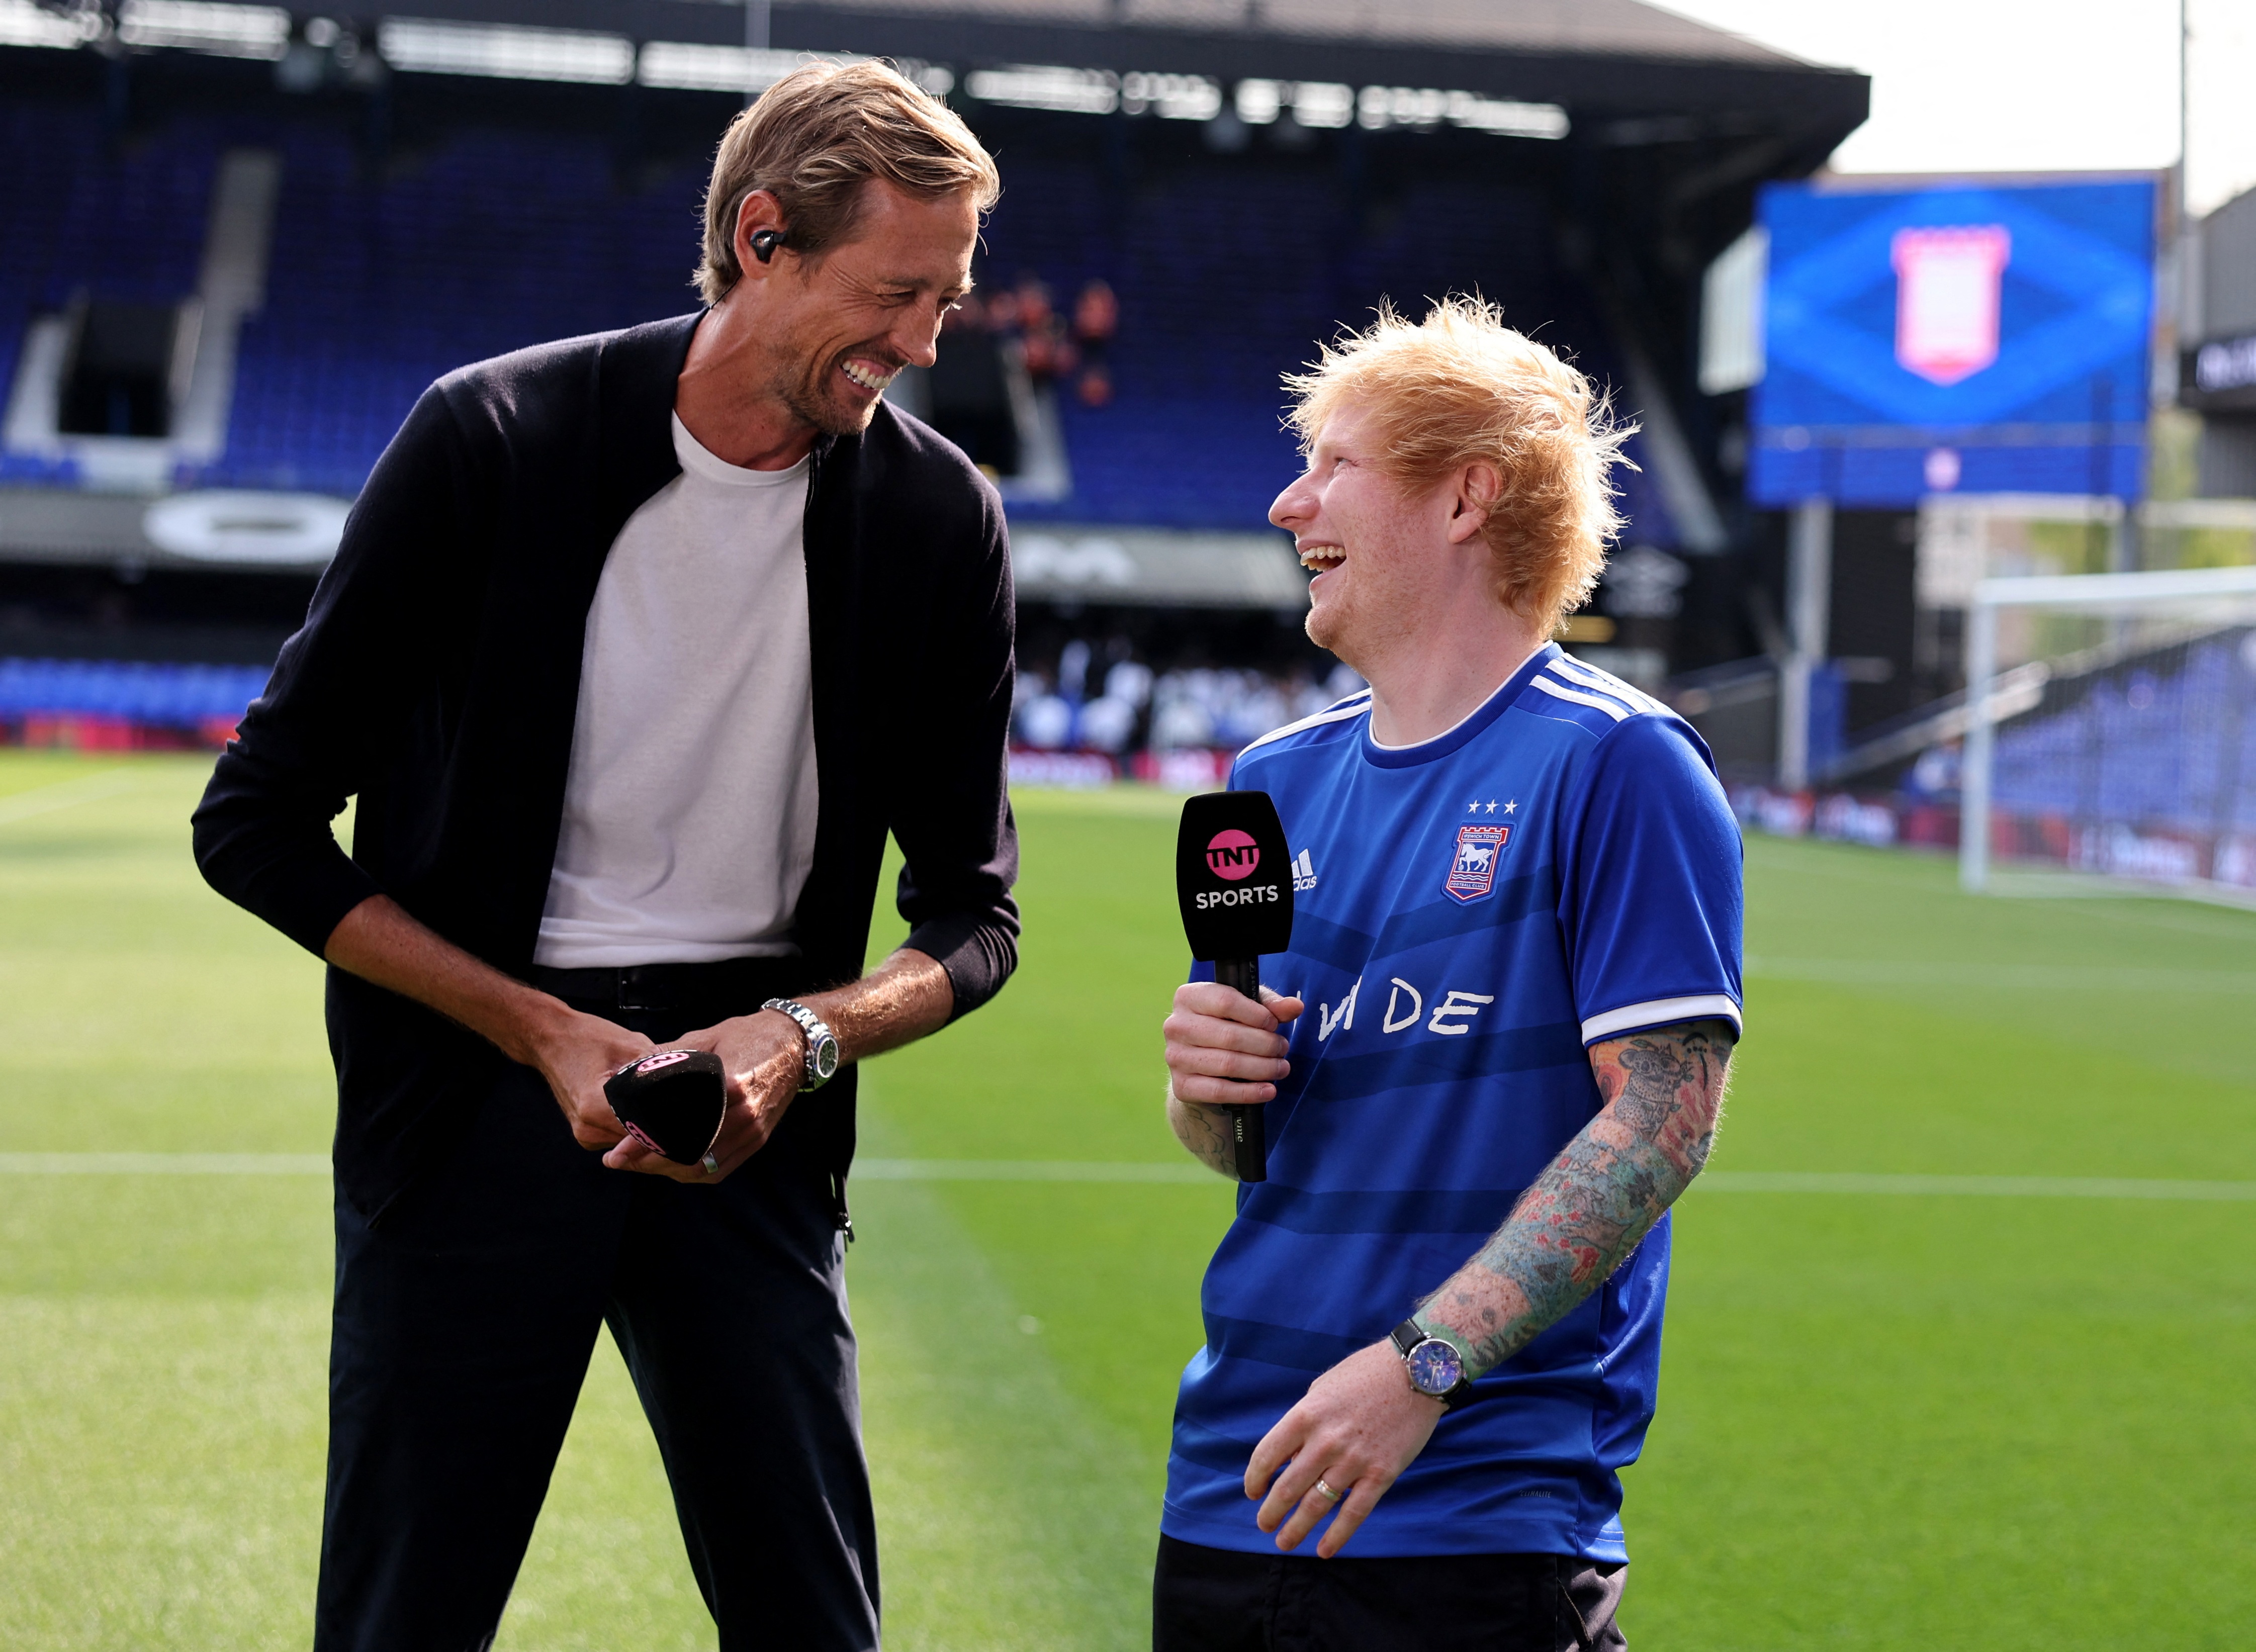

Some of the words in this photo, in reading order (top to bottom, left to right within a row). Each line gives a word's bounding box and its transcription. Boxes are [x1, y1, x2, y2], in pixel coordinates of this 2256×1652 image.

[1207, 845, 1259, 868] TNT
[1293, 876, 1317, 891] das
[1196, 885, 1279, 909] SPORTS
[1520, 1490, 1552, 1498] CLIMALITE
